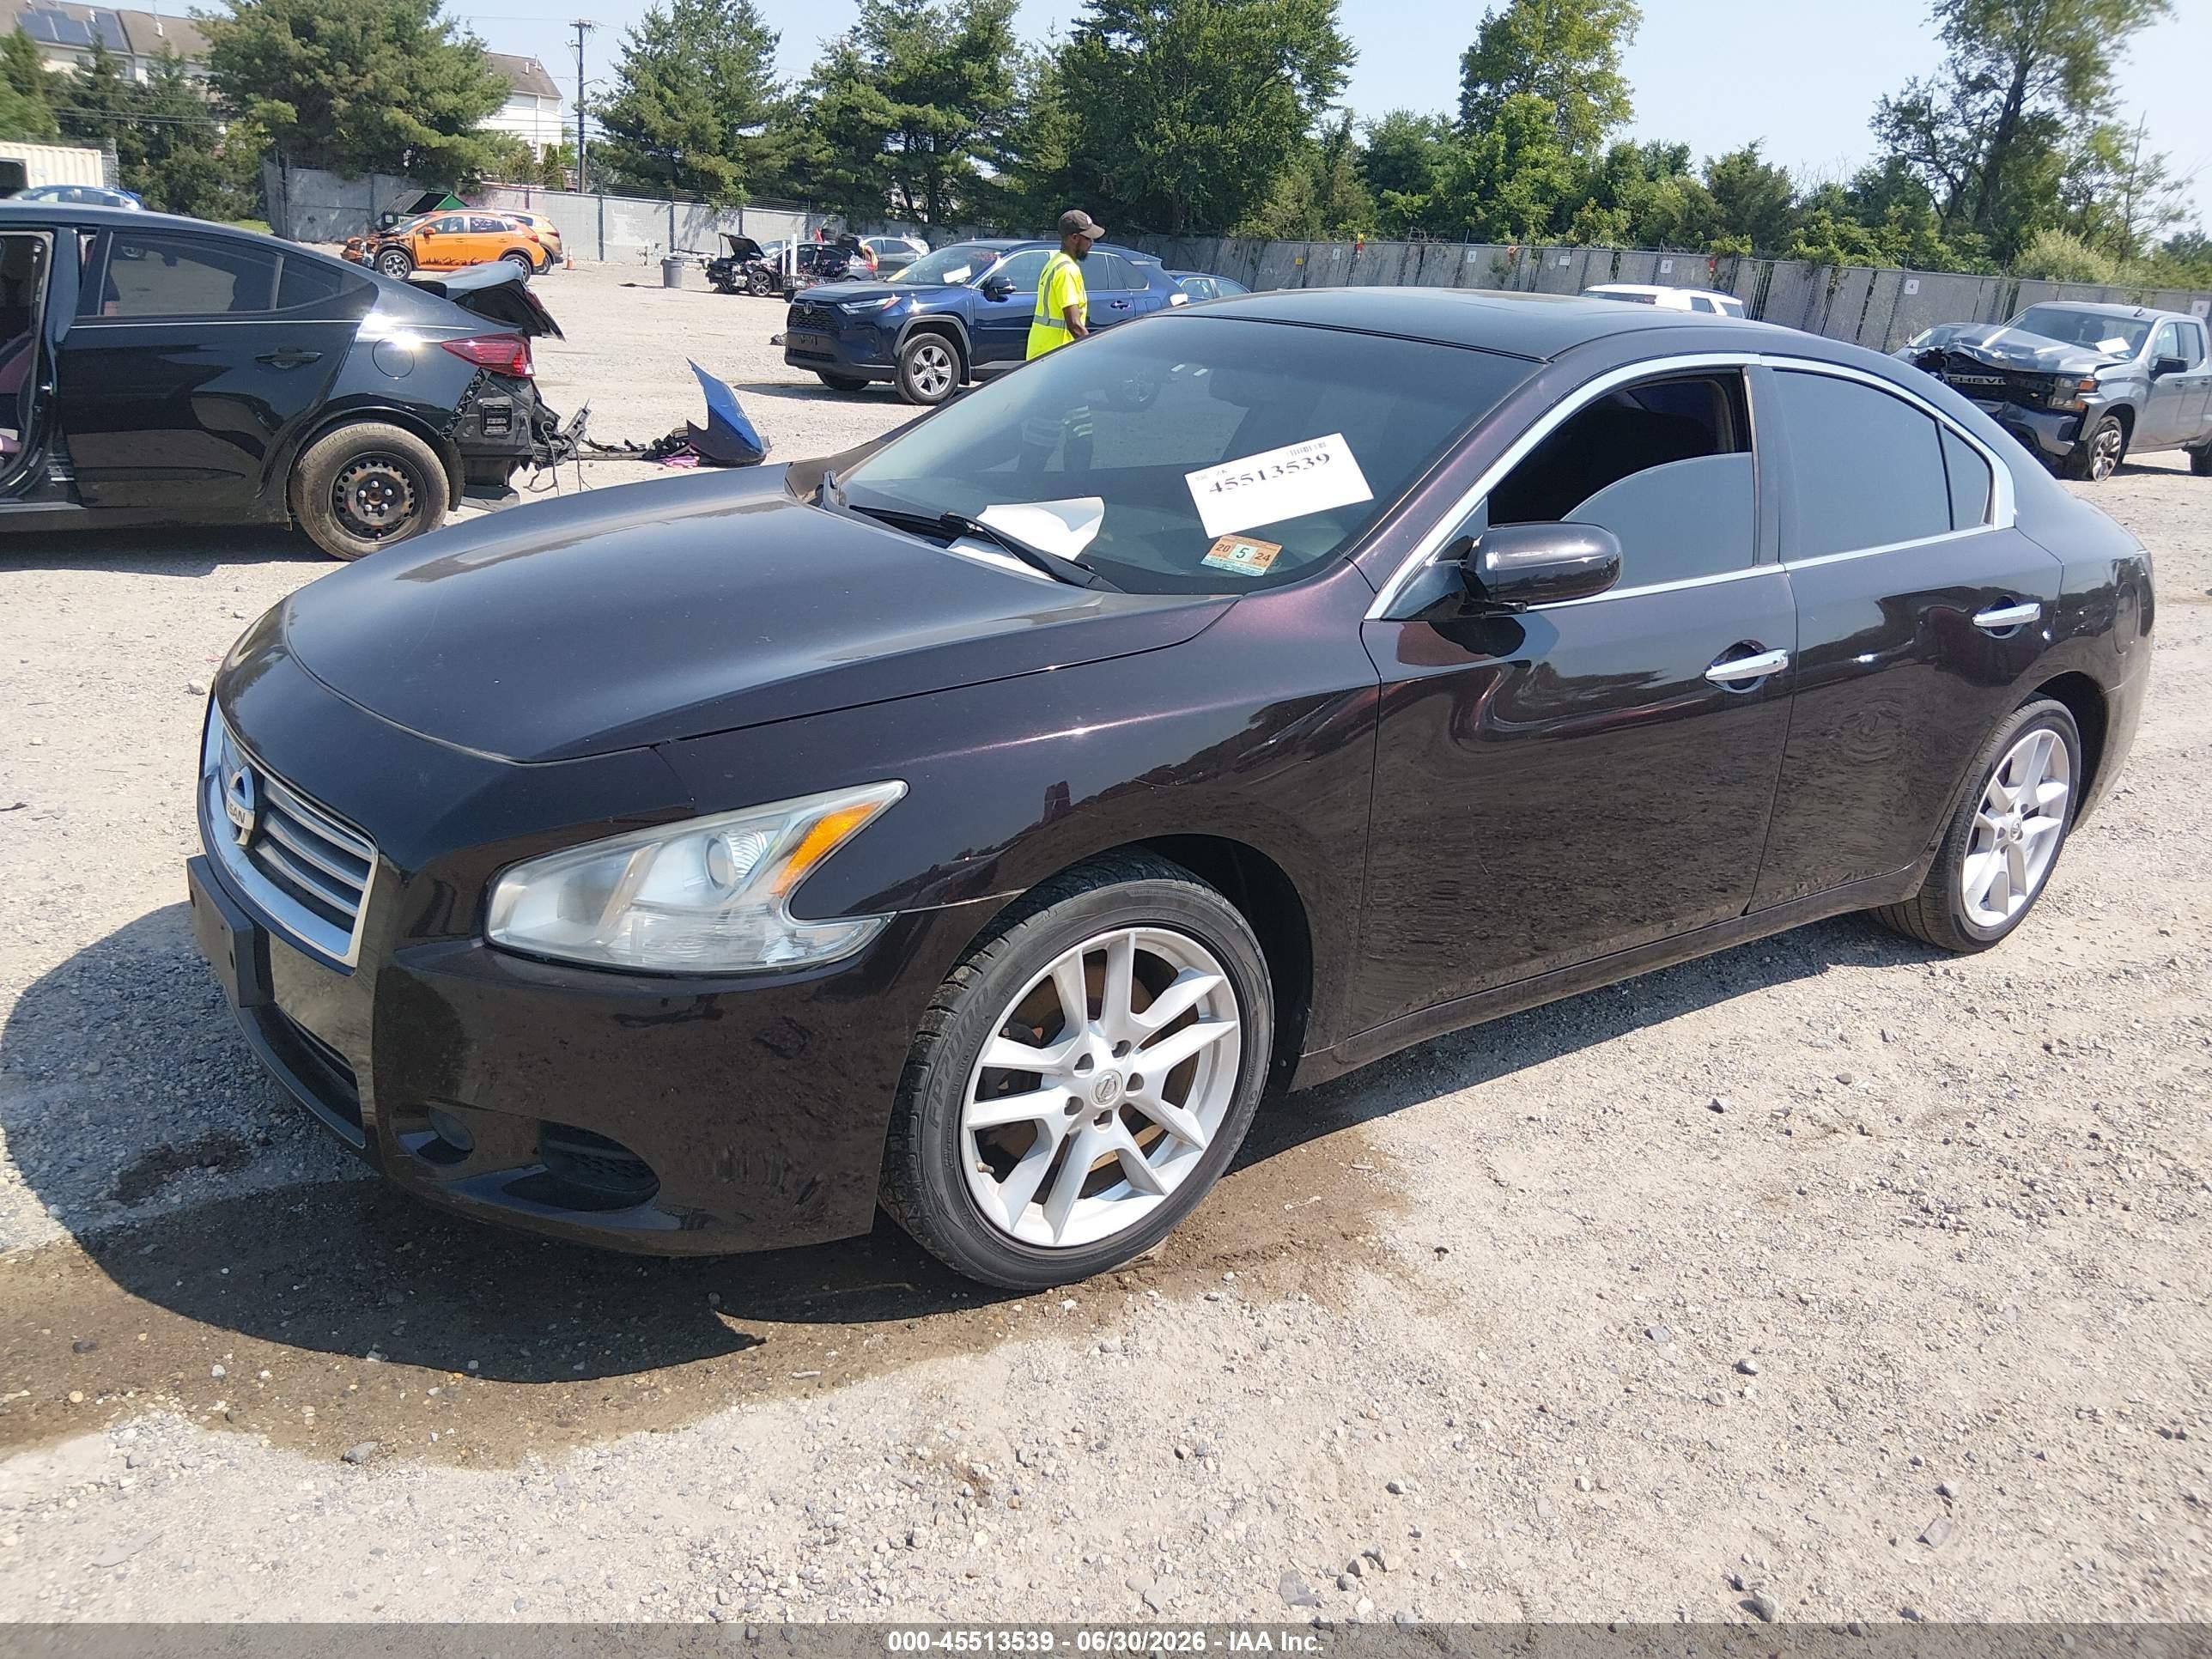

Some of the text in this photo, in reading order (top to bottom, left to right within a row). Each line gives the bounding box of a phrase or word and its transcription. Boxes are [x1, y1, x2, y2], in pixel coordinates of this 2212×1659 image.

[1209, 453, 1330, 493] 45513539
[1215, 543, 1231, 553] 20
[1236, 546, 1249, 559] 5
[1255, 552, 1270, 562] 24
